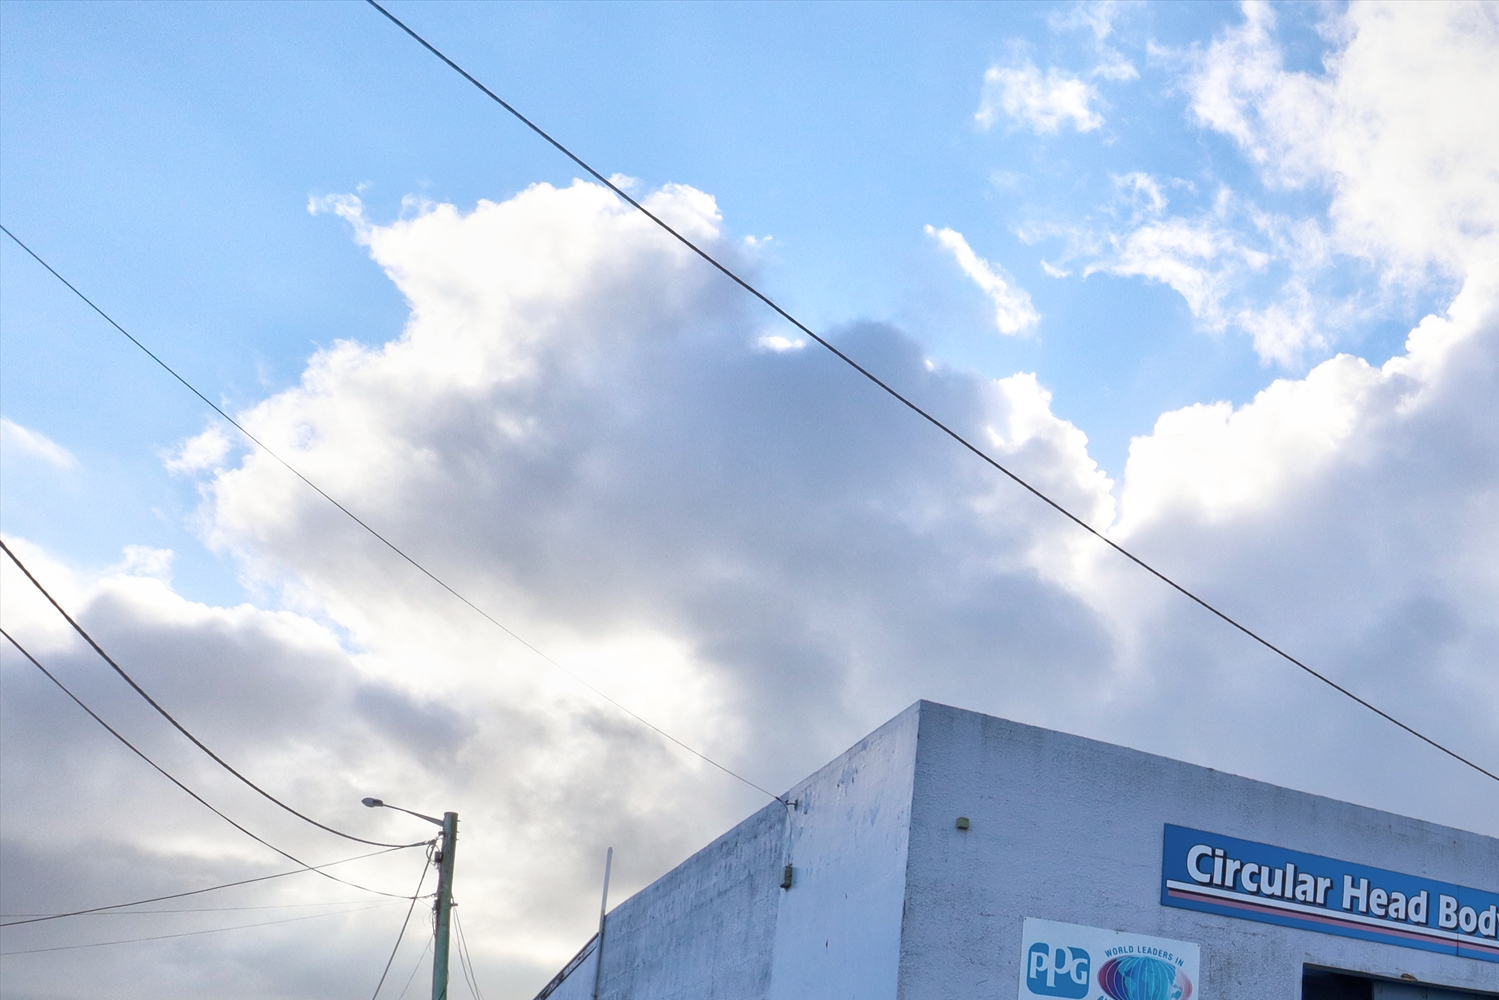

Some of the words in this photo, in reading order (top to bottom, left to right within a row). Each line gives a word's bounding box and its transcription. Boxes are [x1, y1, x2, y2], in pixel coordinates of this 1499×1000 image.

[1186, 844, 1332, 905] Circular
[1342, 874, 1430, 924] Head
[1029, 944, 1089, 988] PPG
[1104, 945, 1134, 958] WORLD
[1137, 945, 1173, 961] LEADERS
[1175, 958, 1185, 967] IN
